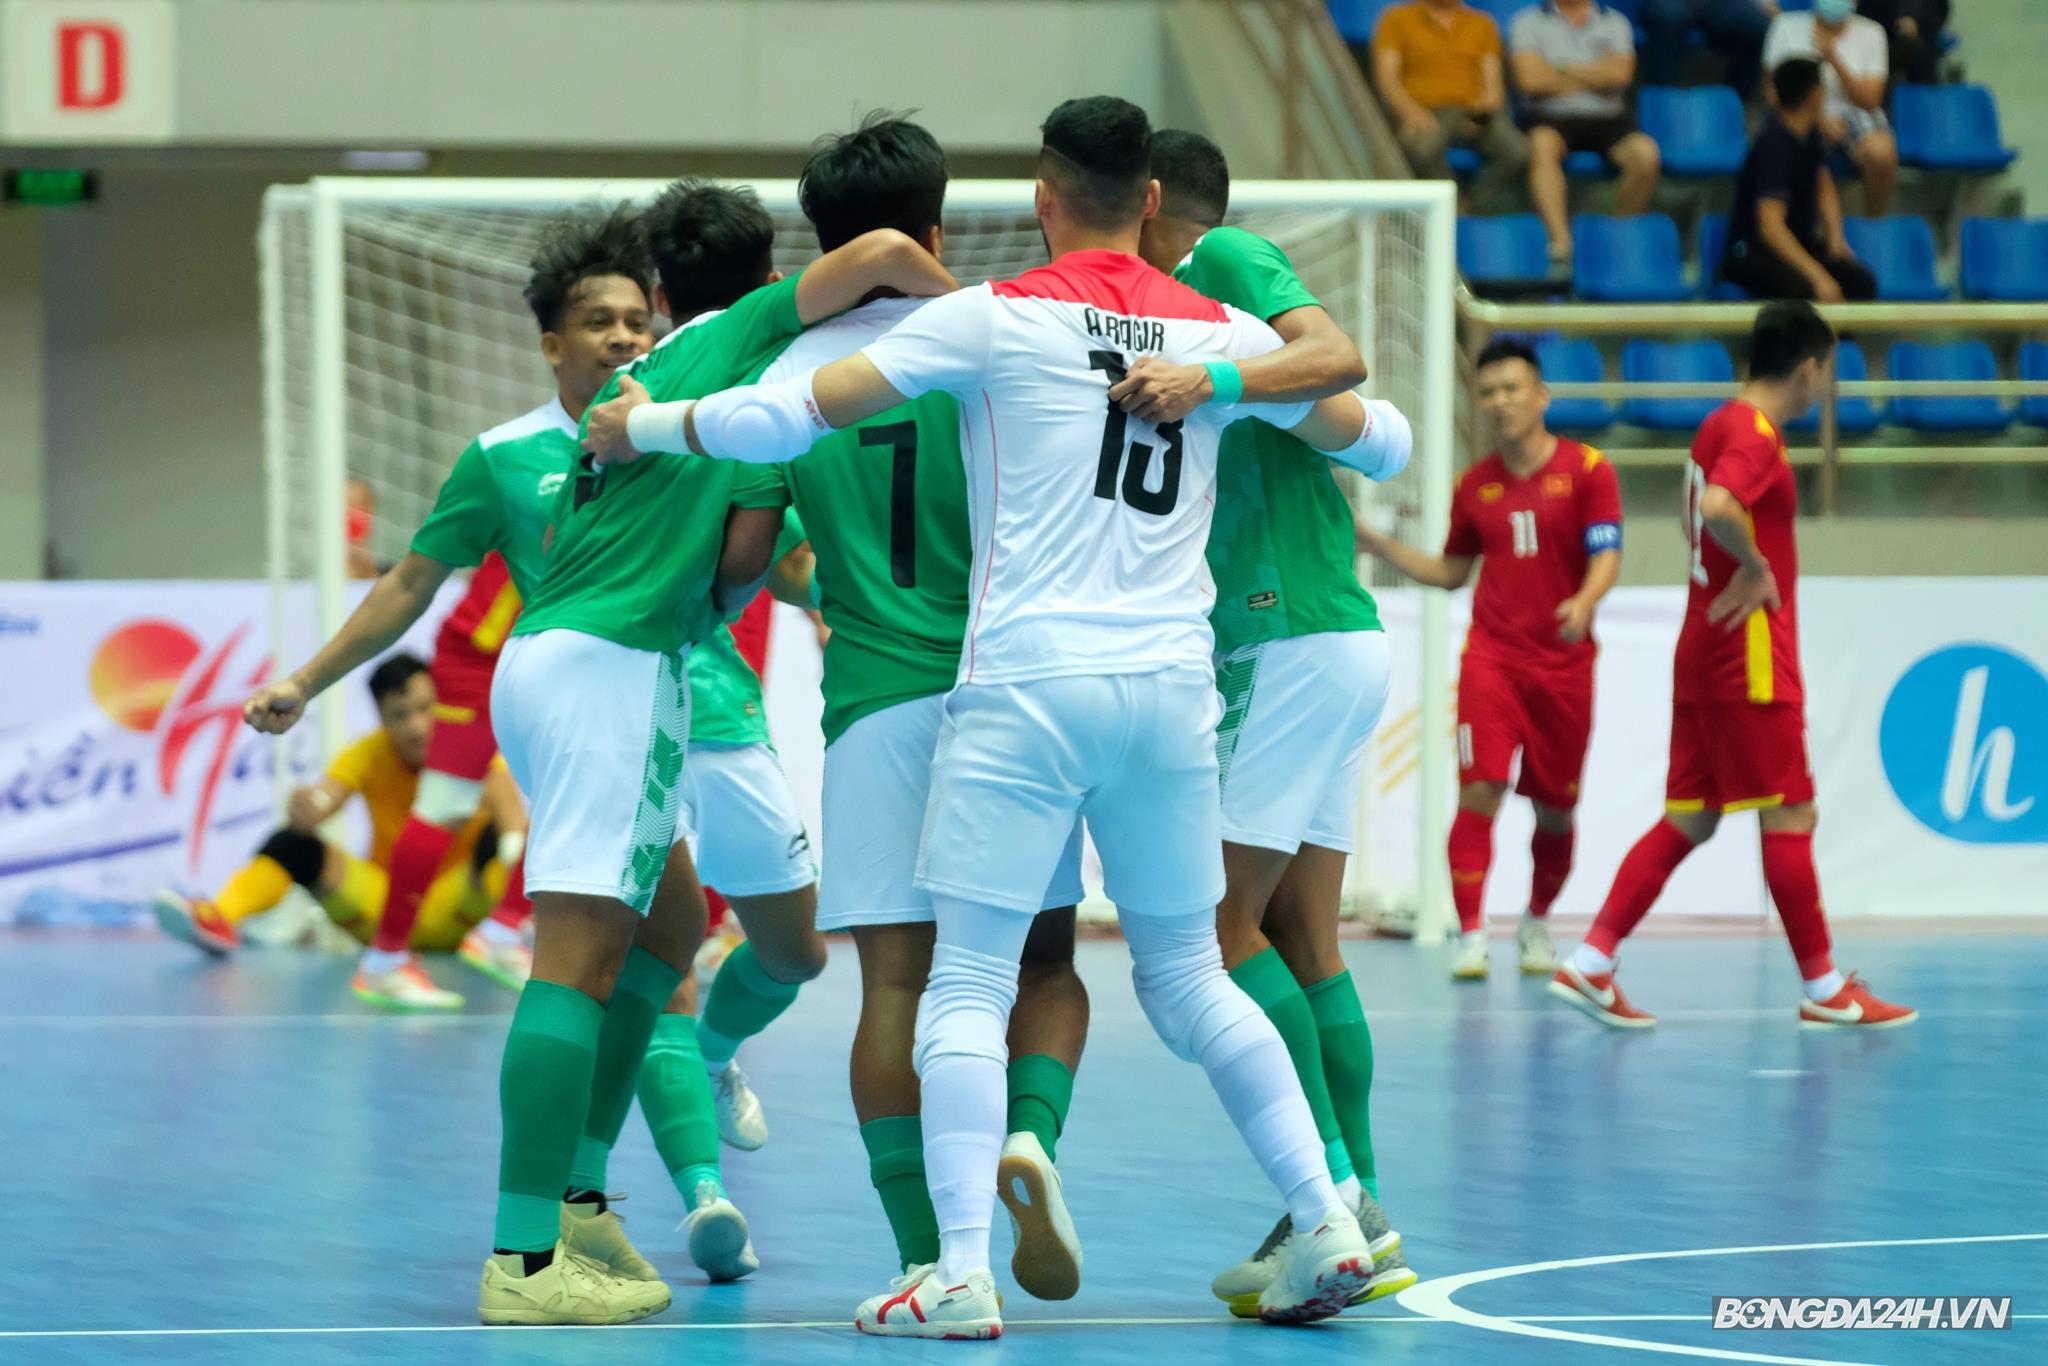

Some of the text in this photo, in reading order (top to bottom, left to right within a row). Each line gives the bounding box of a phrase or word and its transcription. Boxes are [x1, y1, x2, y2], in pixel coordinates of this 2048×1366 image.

[57, 22, 125, 110] D
[858, 419, 917, 588] 7
[1508, 509, 1538, 559] 11
[1942, 664, 2035, 822] h
